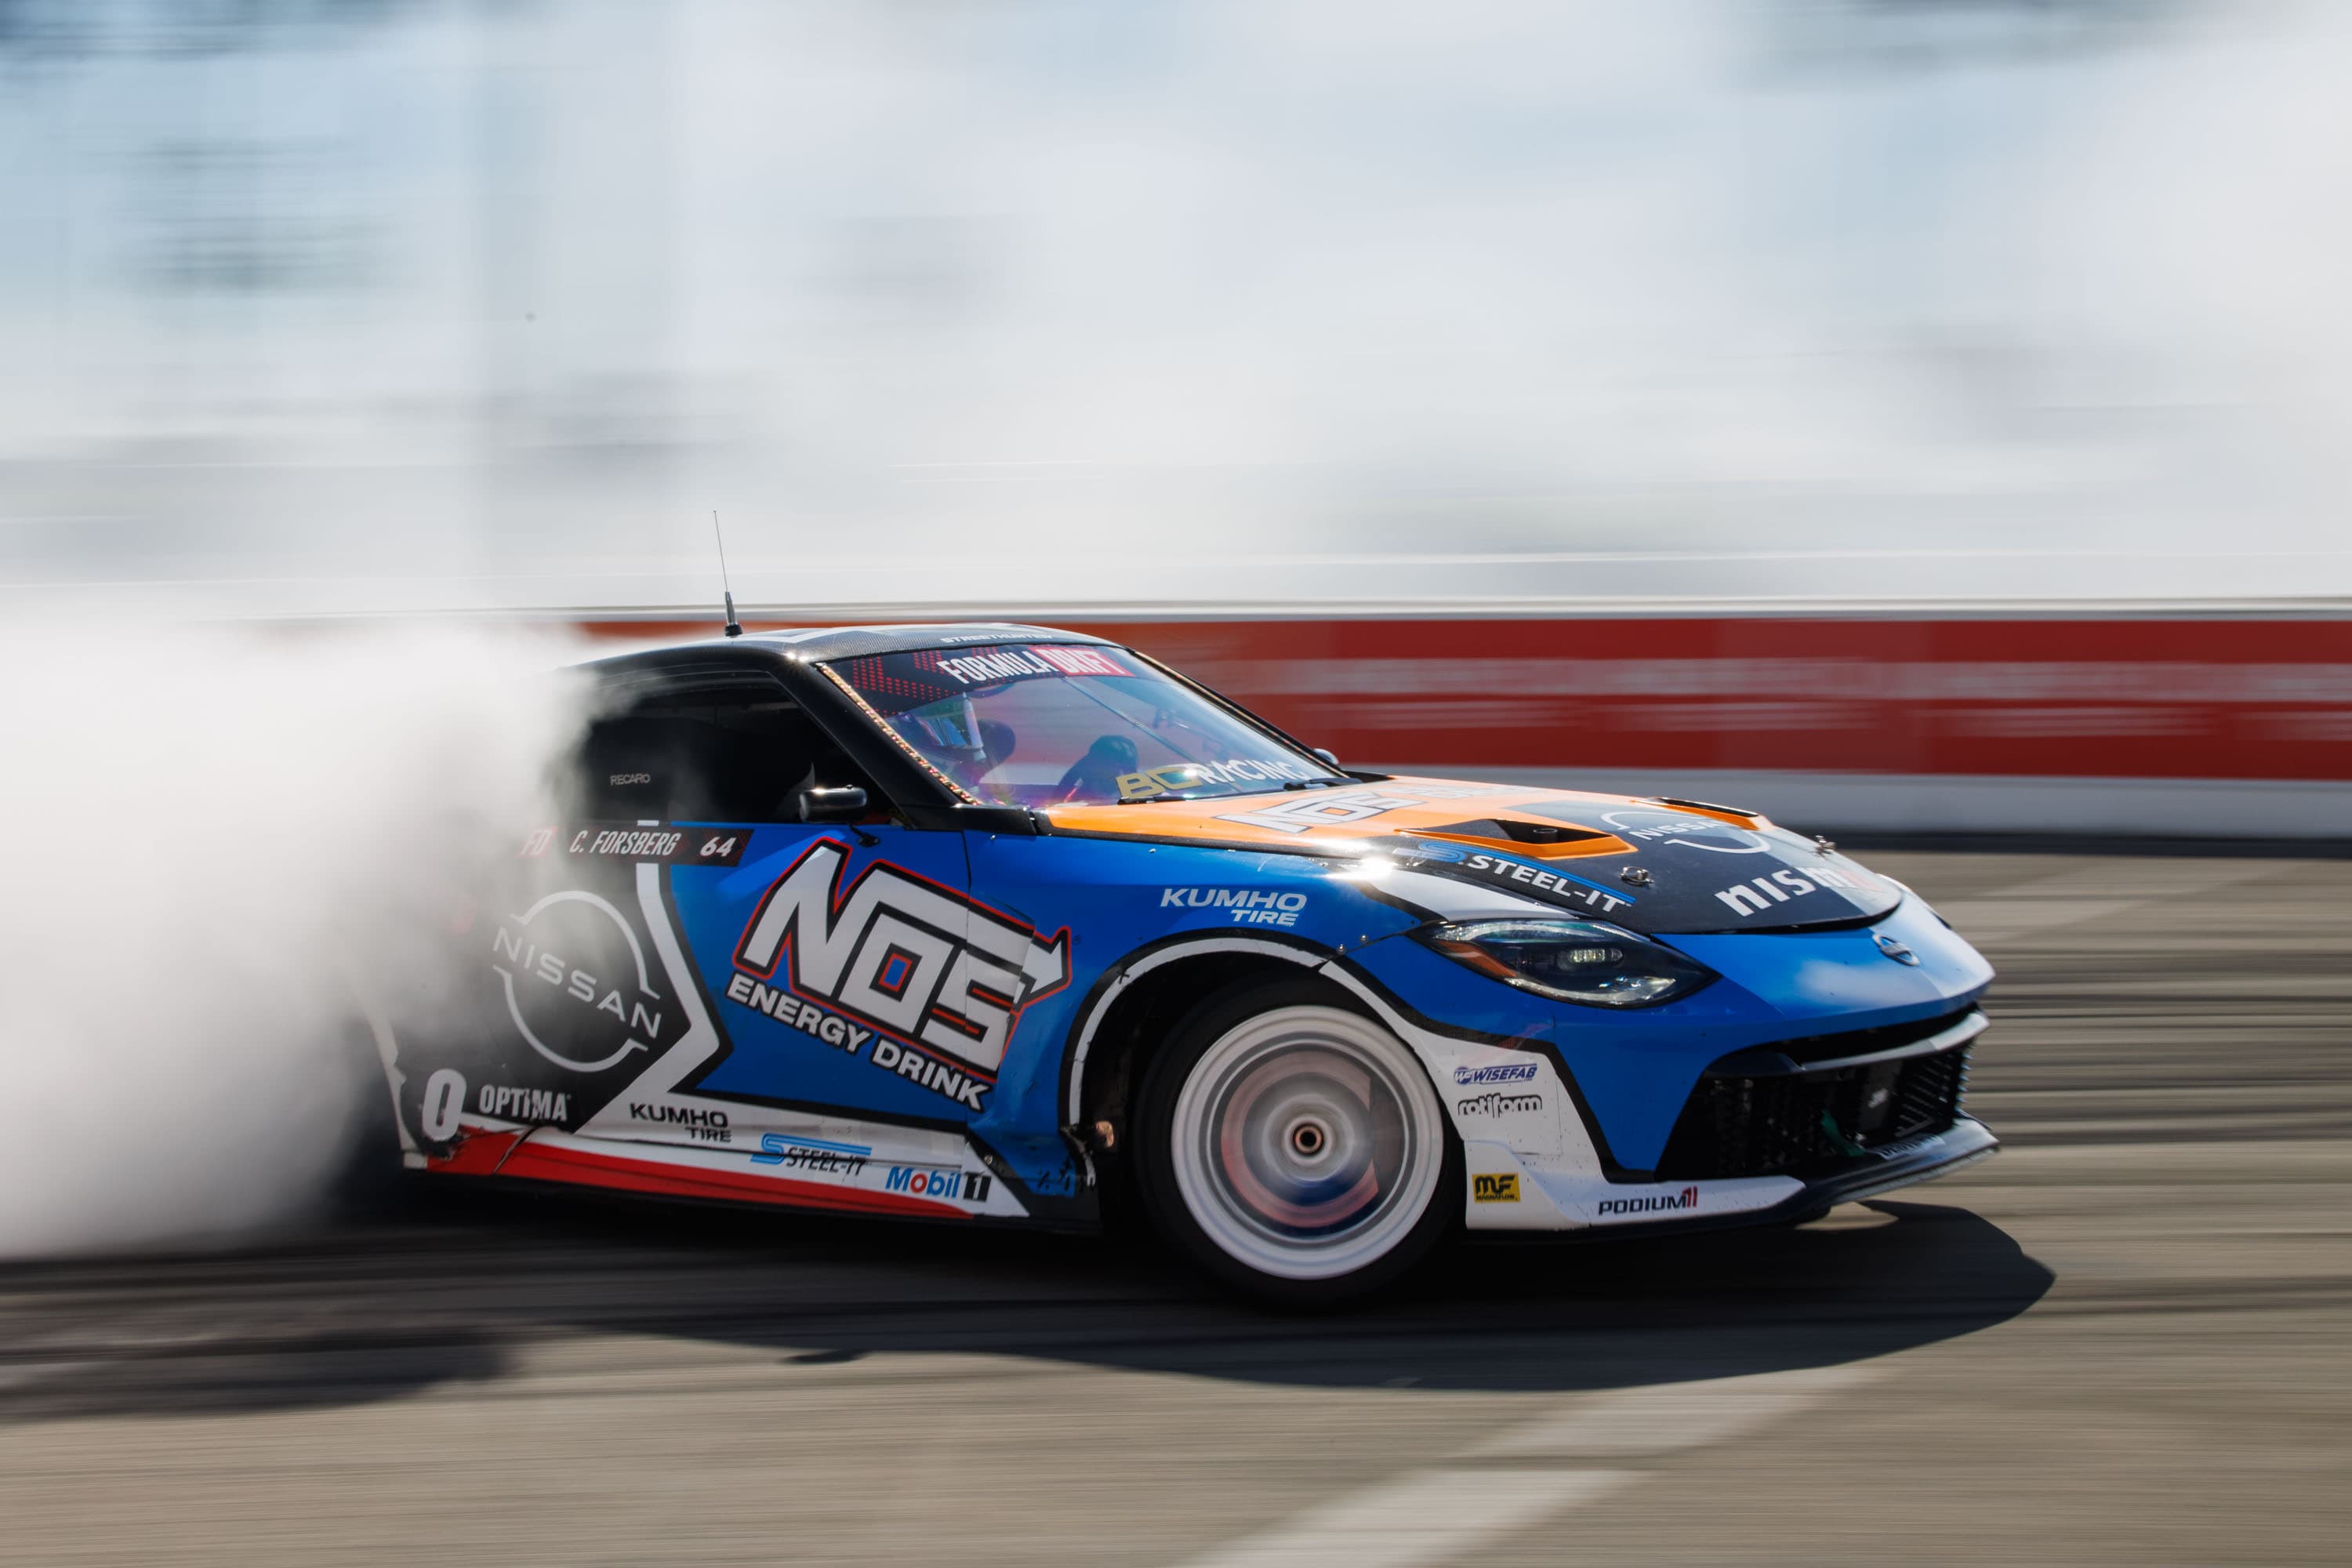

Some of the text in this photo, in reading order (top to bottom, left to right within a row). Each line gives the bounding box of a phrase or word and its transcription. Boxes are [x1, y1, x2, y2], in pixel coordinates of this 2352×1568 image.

[936, 648, 1126, 684] FORMULA DRIFT
[610, 774, 651, 786] RECARO
[1213, 791, 1429, 833] NOS
[520, 829, 552, 856] FD
[569, 829, 736, 857] C. FORSBERG 64
[1467, 855, 1626, 913] STEEL-IT
[1160, 887, 1307, 912] KUMHO
[1231, 909, 1300, 927] TIRE
[737, 840, 1068, 1079] NOS
[492, 927, 662, 1039] NISSAN
[728, 977, 990, 1110] ENERGY DRINK
[1474, 1065, 1537, 1082] WISEFAB
[479, 1084, 568, 1122] OPTIMA
[630, 1103, 728, 1129] KUMHO
[1458, 1092, 1542, 1118] rotiform
[684, 1127, 731, 1143] TIRE
[786, 1146, 869, 1176] STEEL-IT
[886, 1166, 962, 1199] Mobil
